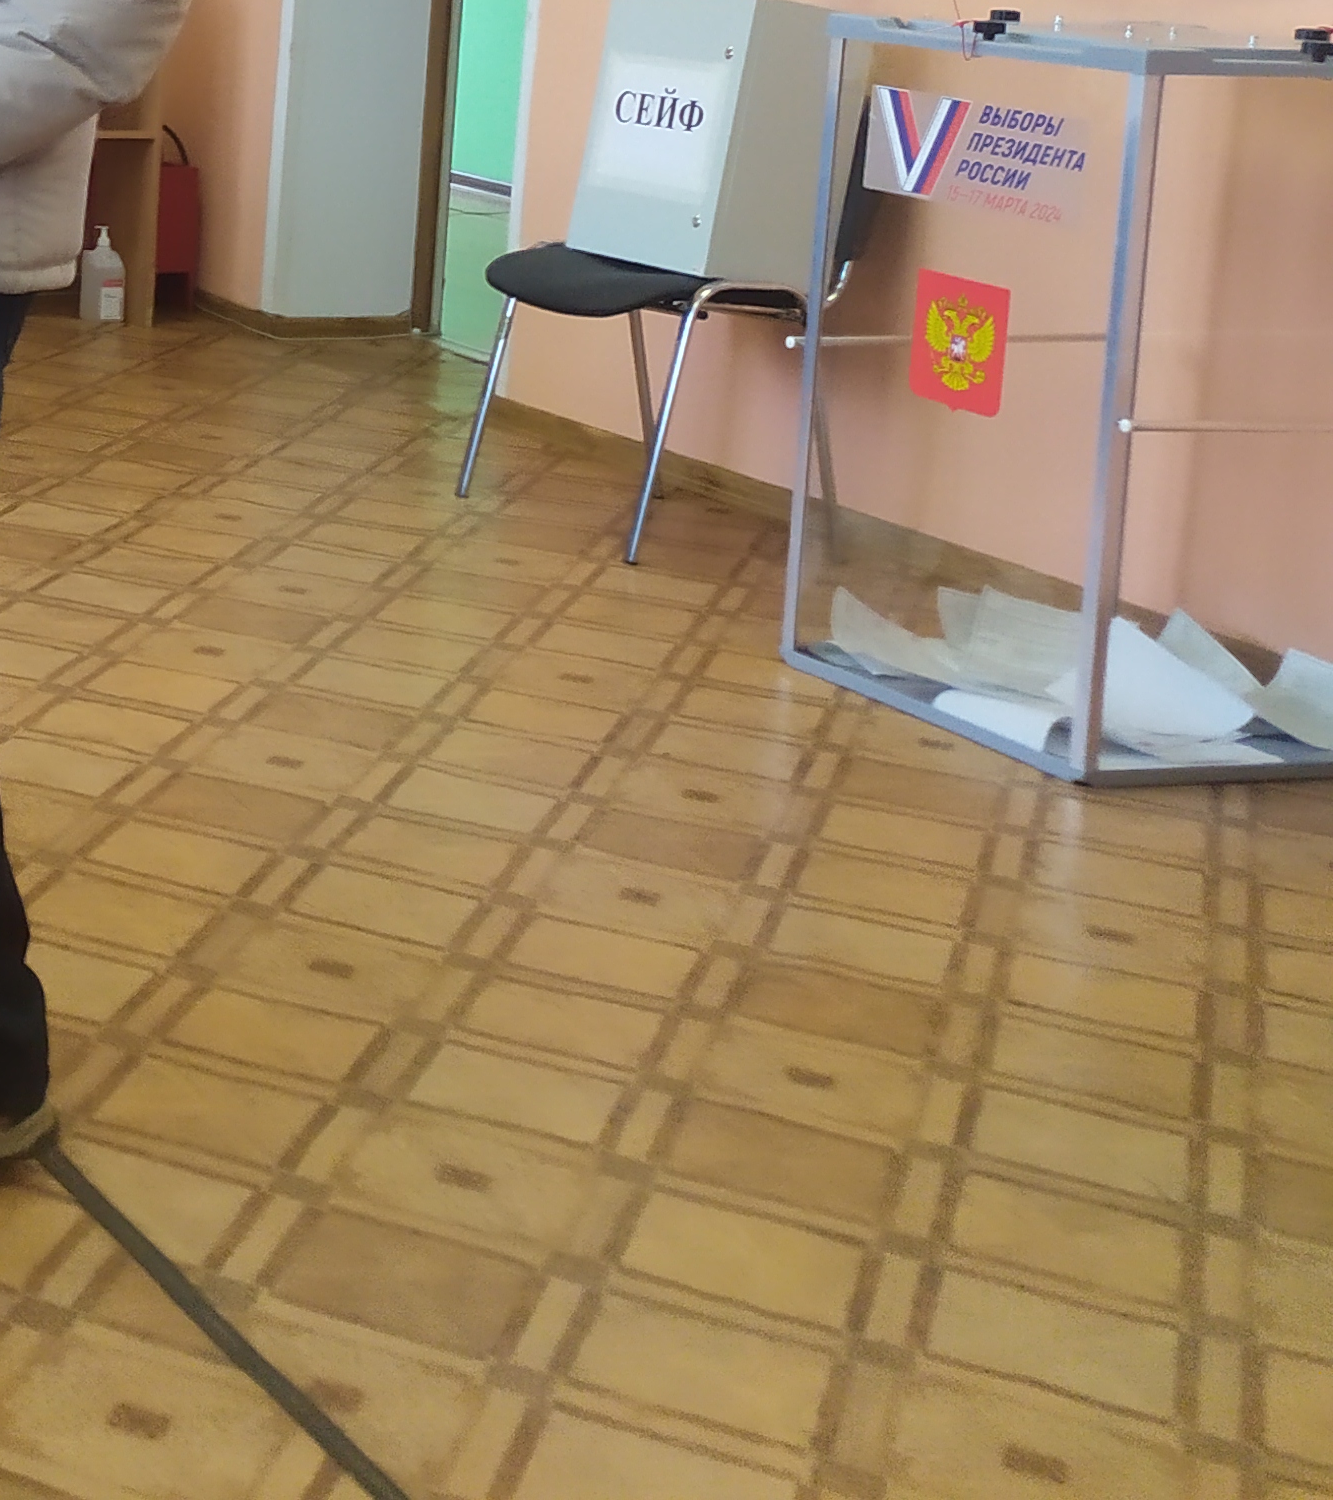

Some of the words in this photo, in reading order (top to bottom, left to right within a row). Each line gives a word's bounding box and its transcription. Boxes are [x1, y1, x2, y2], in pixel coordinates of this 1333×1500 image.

[615, 87, 704, 132] СЕЙФ
[979, 104, 1065, 137] ВЫБОРЫ
[966, 132, 1086, 172] ПРЕЗИДЕНТА
[955, 159, 1032, 191] РОССИИ
[983, 192, 1029, 216] МАРТА
[1029, 202, 1063, 223] 2024
